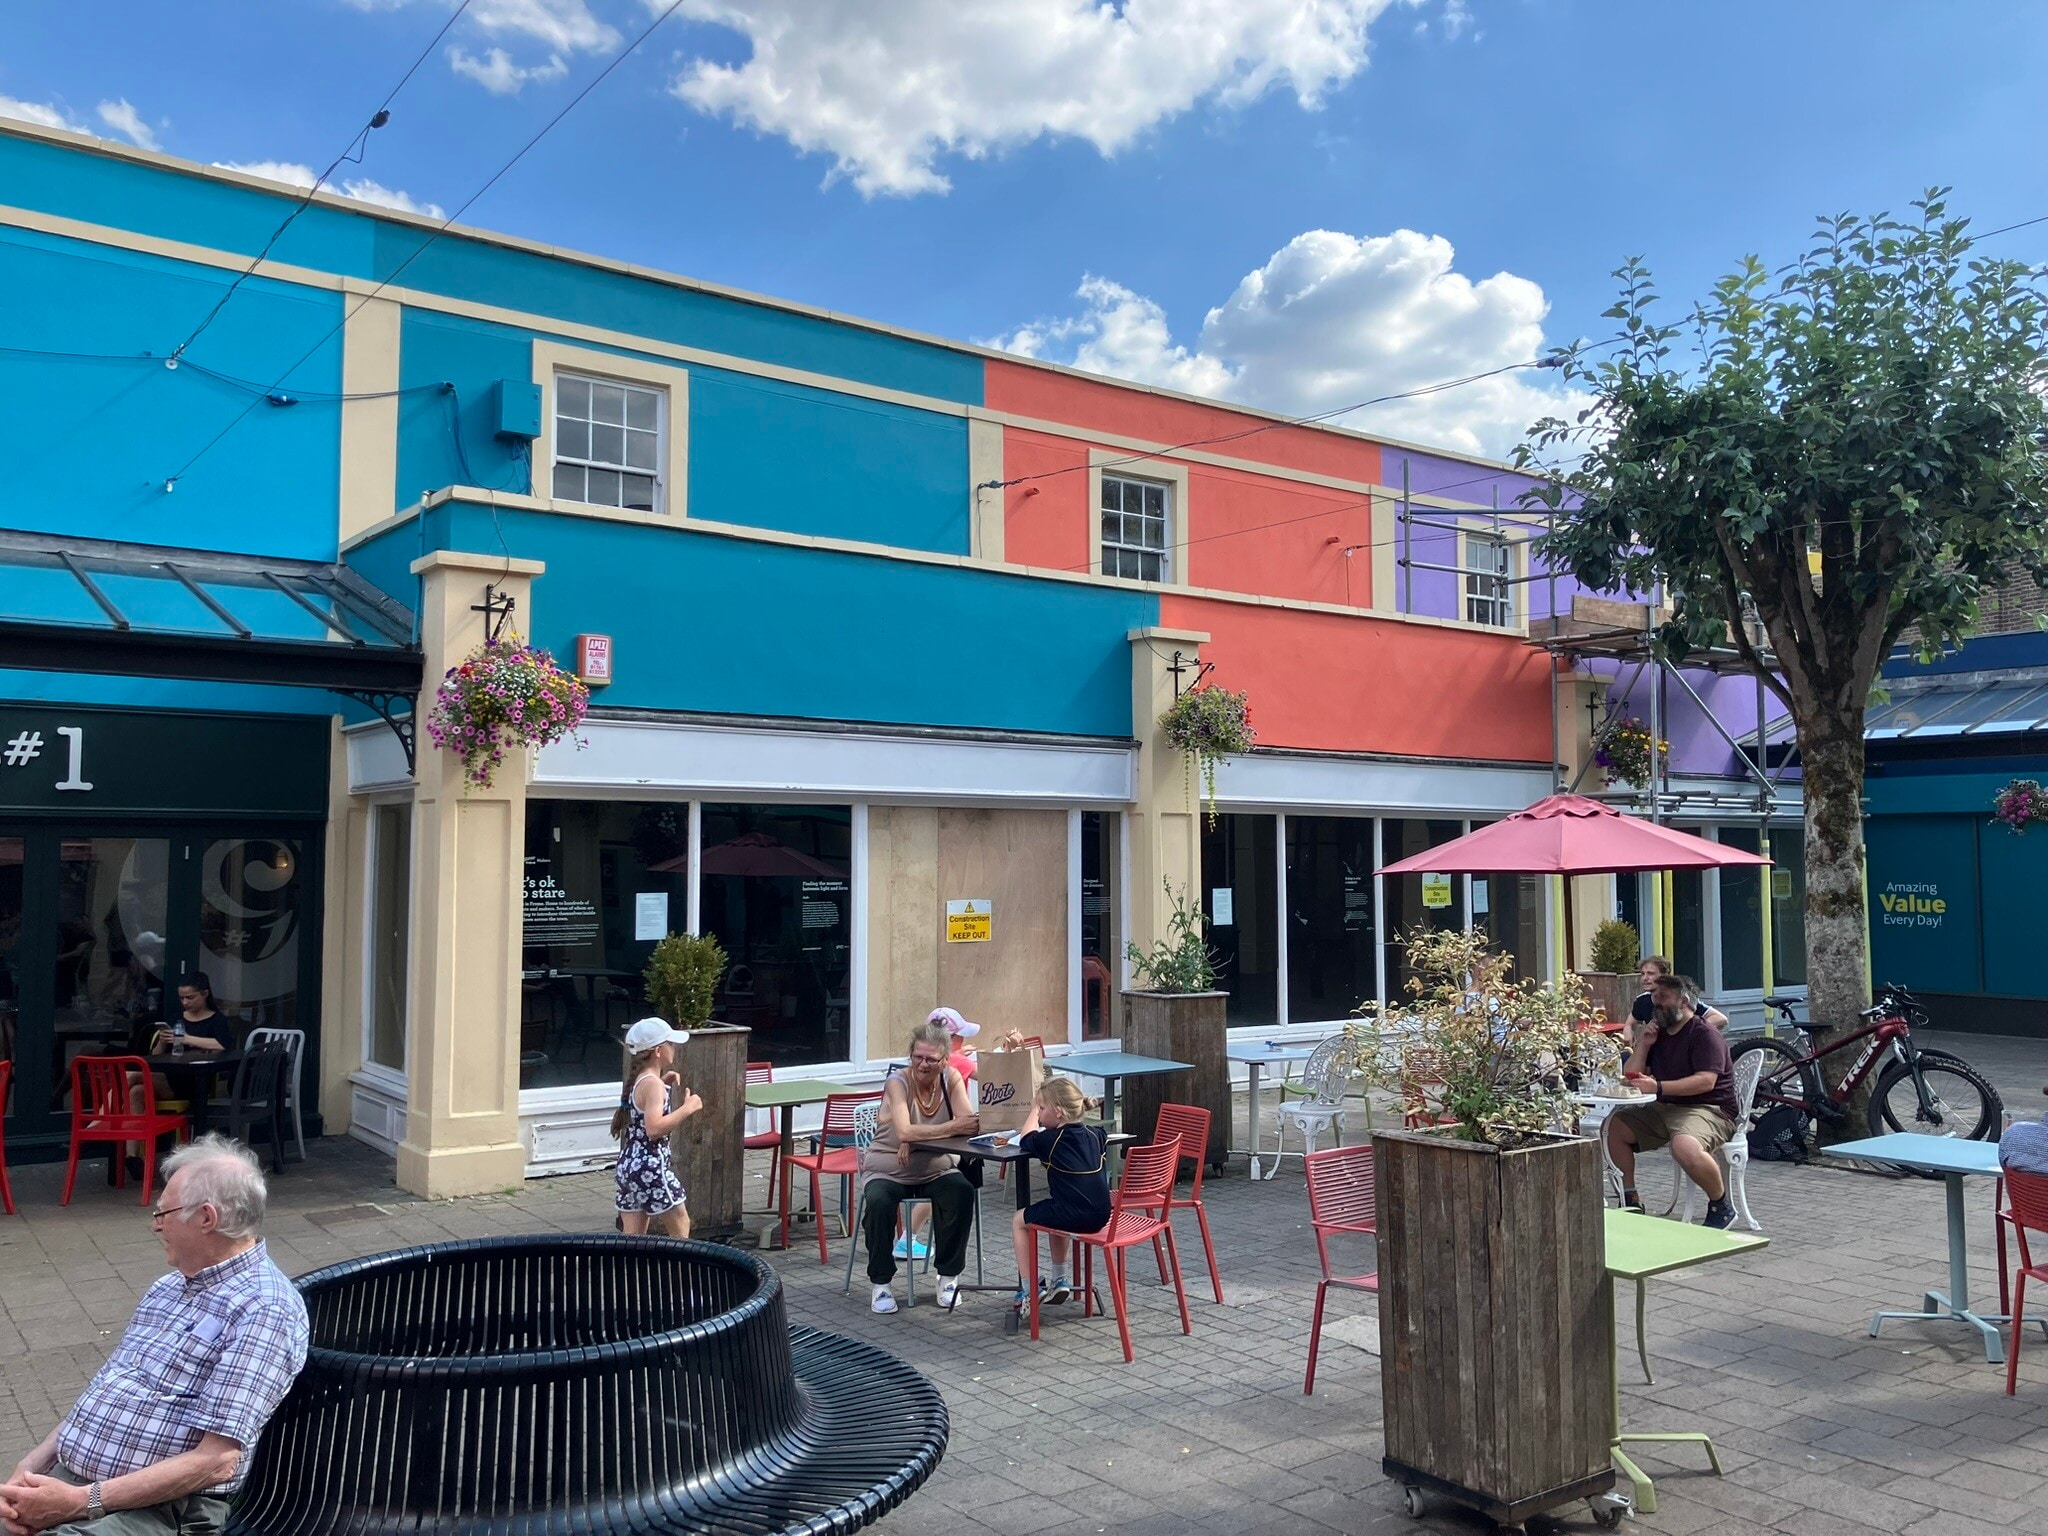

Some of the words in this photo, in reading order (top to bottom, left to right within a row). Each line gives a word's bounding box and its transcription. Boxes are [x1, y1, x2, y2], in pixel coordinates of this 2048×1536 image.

[590, 640, 606, 650] APEX
[539, 875, 556, 888] ok
[532, 889, 565, 898] stare
[1886, 882, 1938, 895] Amazing
[1879, 894, 1946, 914] Value
[1884, 914, 1914, 927] Every
[1917, 914, 1942, 928] Day!
[1837, 1034, 1881, 1092] TREK
[980, 1082, 1016, 1106] Boots
